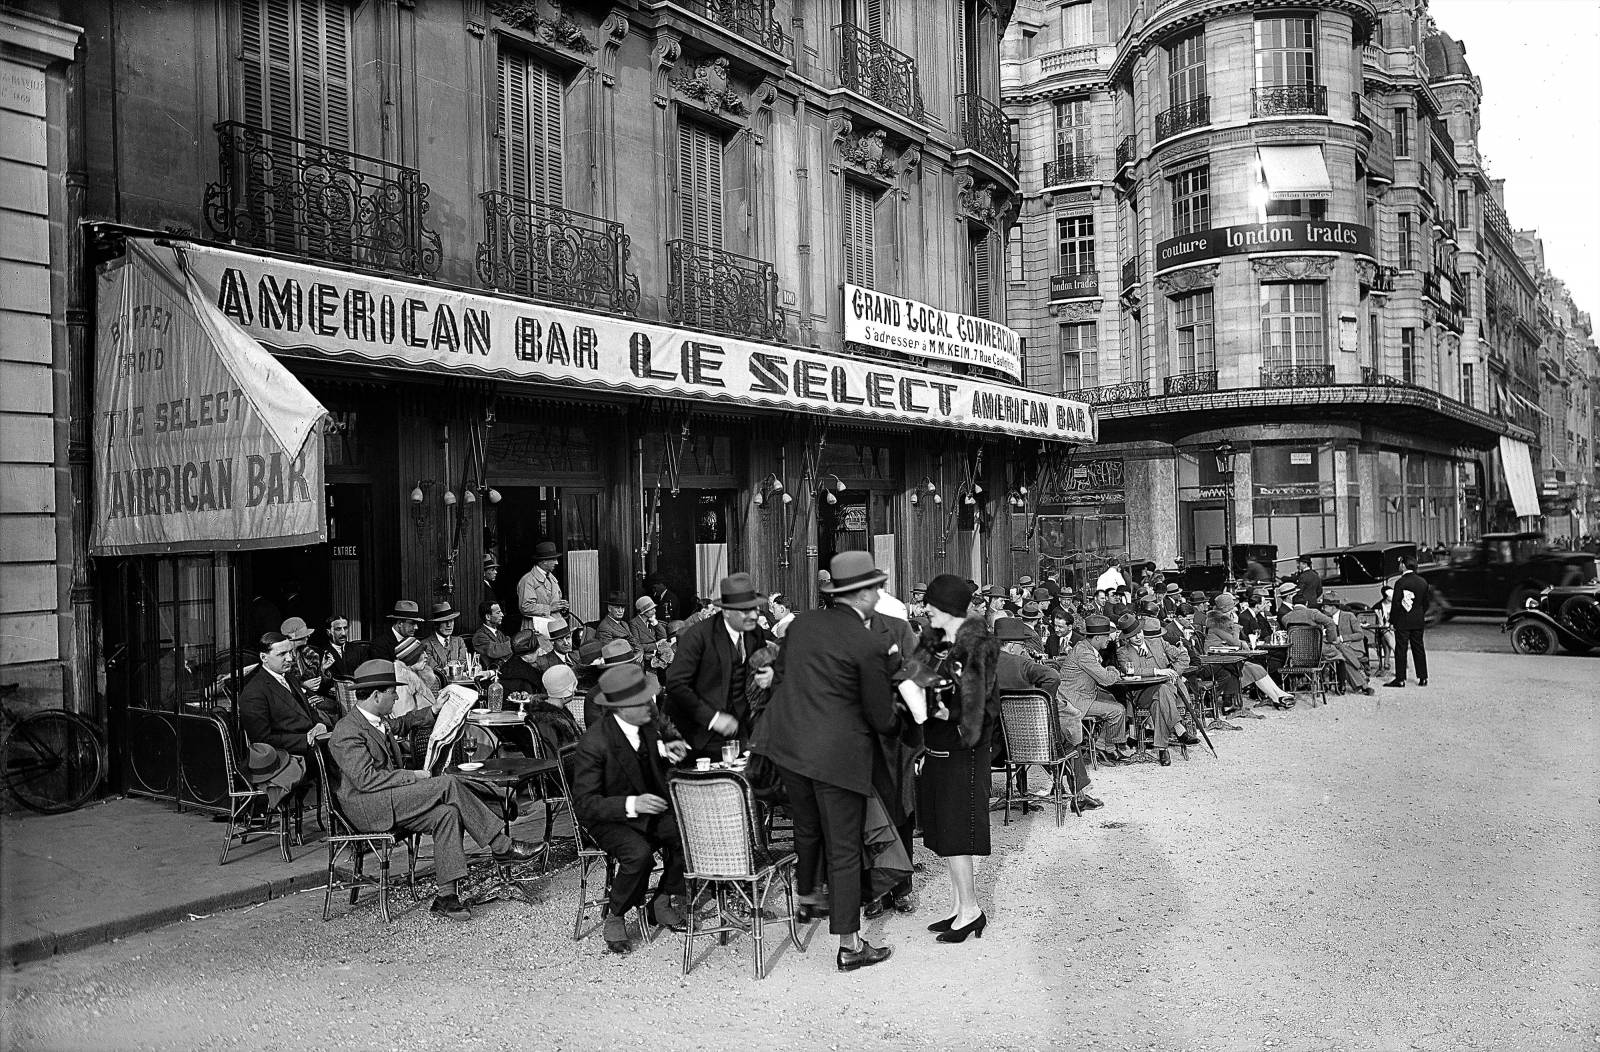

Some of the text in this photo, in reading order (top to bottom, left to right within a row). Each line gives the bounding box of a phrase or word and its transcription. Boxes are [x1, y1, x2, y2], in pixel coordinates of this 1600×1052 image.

[1162, 238, 1207, 259] couture
[1225, 223, 1294, 248] london
[1306, 223, 1357, 245] trades
[783, 290, 795, 304] 100
[1051, 277, 1098, 292] london trades
[852, 289, 900, 327] GRAND
[906, 301, 953, 339] LOCAL
[956, 315, 1016, 356] COMMERCIAL
[118, 347, 164, 379] FROID
[217, 267, 1086, 432] AMERICAN BAR LE SELECT AMERICAN BAR
[865, 326, 920, 349] S'adresser
[979, 350, 992, 364] Rue
[153, 388, 246, 433] SELECT
[108, 450, 312, 520] AMERICAN BAR
